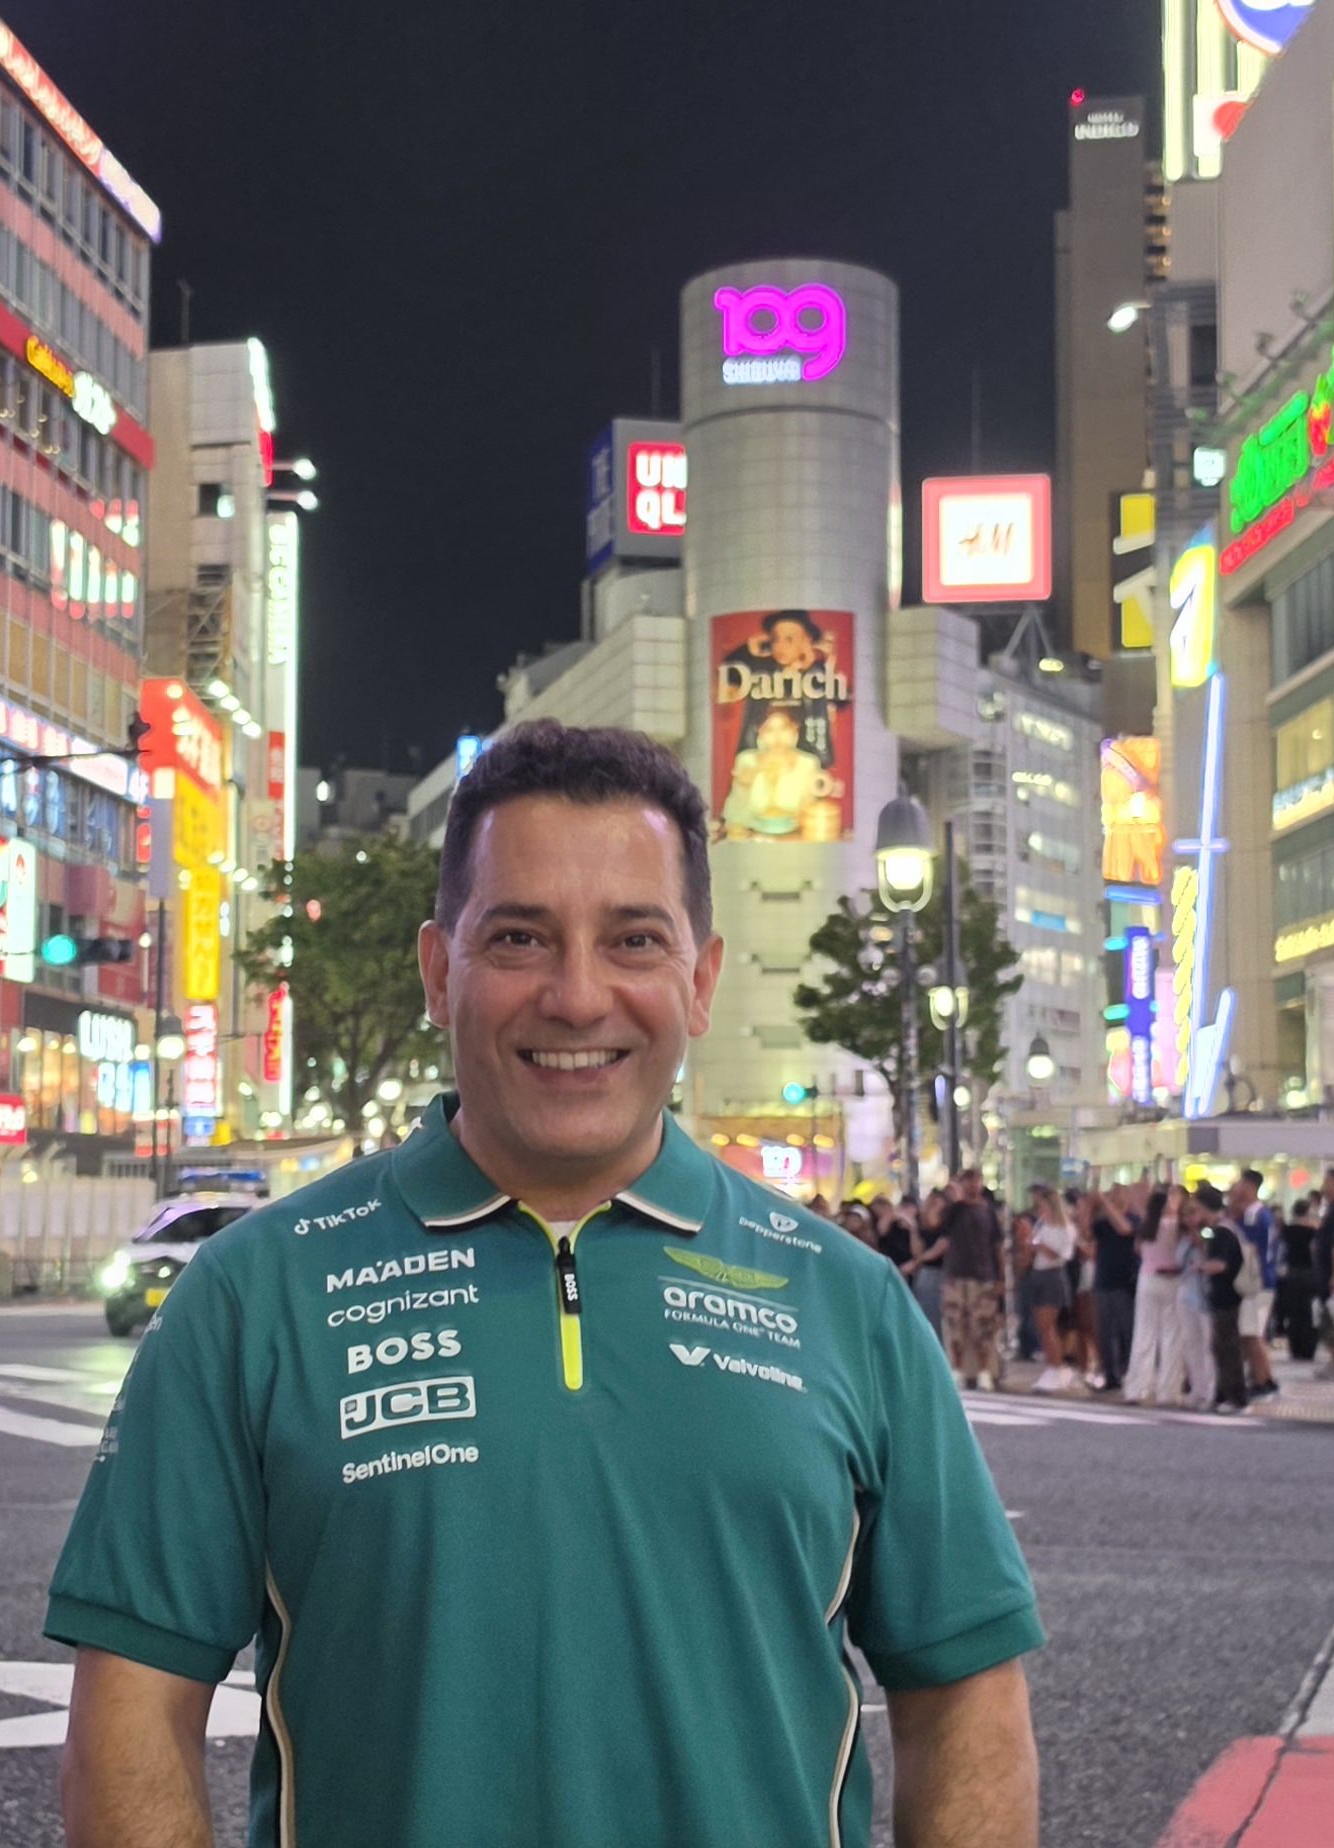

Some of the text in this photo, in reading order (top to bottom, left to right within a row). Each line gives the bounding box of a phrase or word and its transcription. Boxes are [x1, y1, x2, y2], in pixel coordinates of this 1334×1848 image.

[714, 283, 847, 382] 109
[717, 653, 848, 704] Darich
[313, 1198, 382, 1231] TikTok
[738, 1214, 822, 1255] pepperstone
[327, 1283, 480, 1328] cognizant
[663, 1285, 798, 1334] aramco
[347, 1329, 461, 1374] BOSS
[664, 1308, 730, 1332] FORMULA
[767, 1329, 801, 1350] TEAM
[713, 1353, 805, 1390] Valvoline
[343, 1380, 472, 1433] JCB
[342, 1443, 479, 1484] SentinelOne
